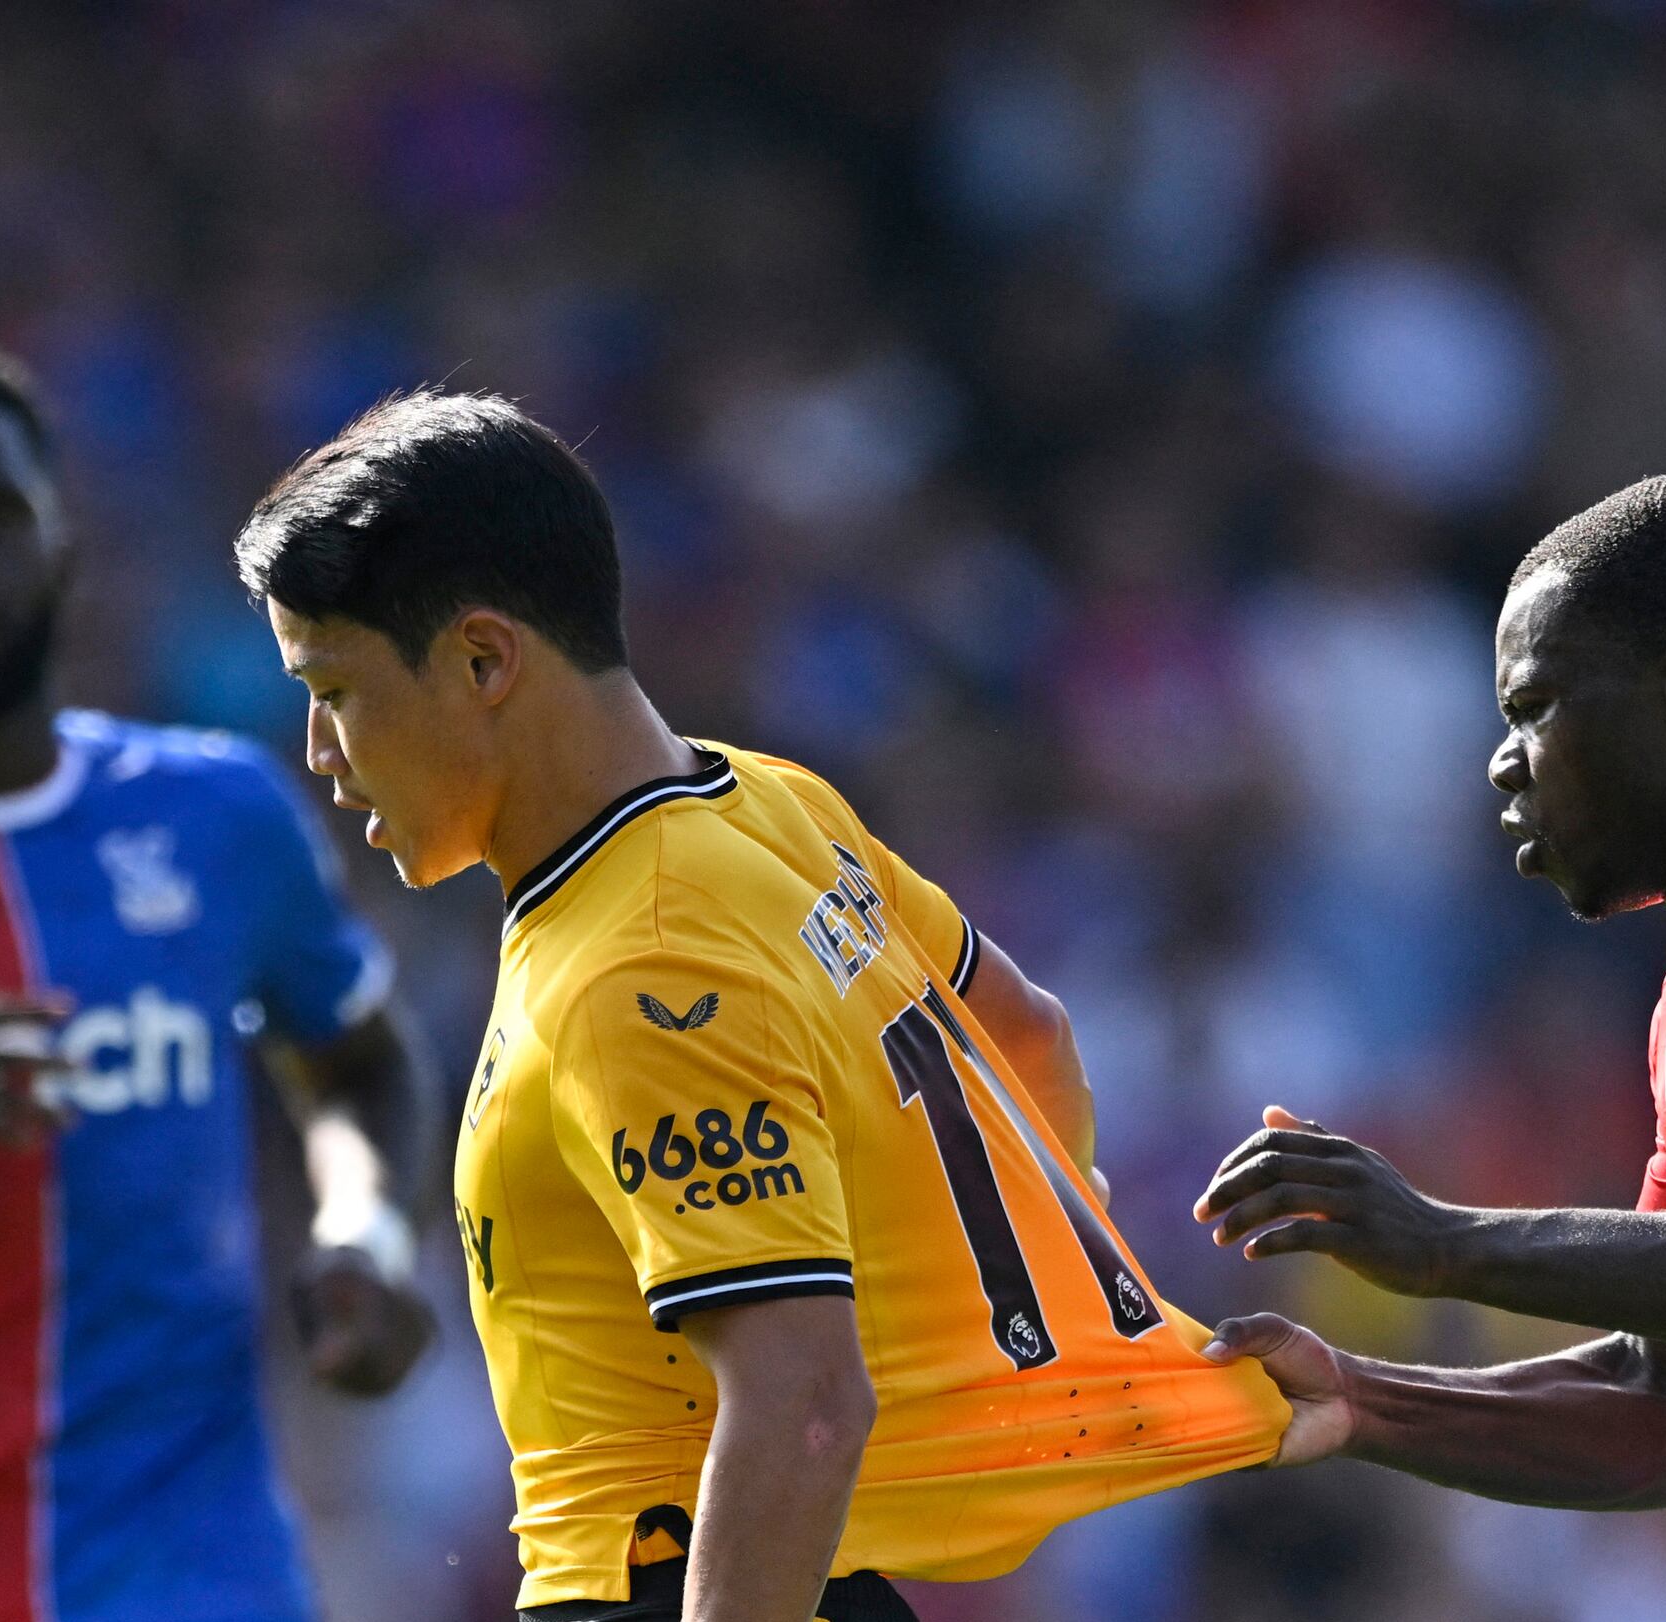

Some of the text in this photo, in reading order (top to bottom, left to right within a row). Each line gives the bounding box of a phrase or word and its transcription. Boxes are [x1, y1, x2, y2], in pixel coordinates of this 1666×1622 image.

[612, 1100, 789, 1195] 6686
[675, 1162, 805, 1215] .com
[878, 976, 1167, 1372] 11
